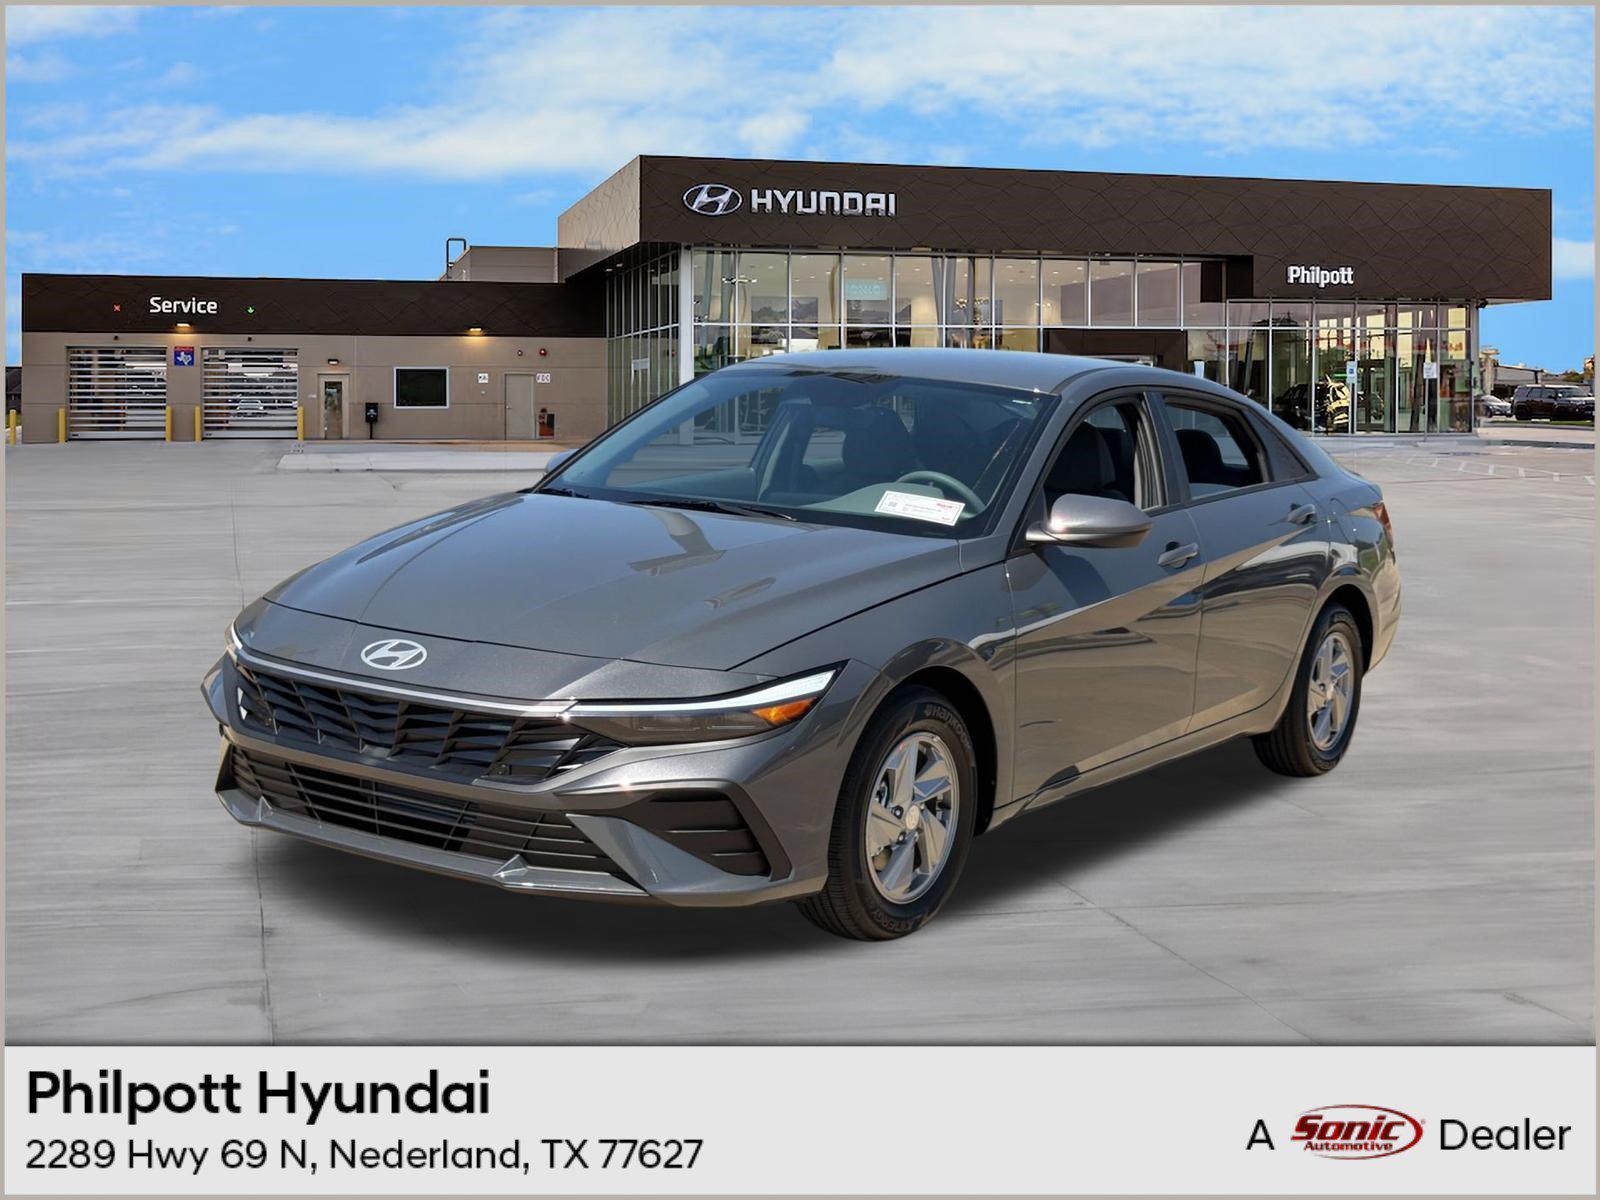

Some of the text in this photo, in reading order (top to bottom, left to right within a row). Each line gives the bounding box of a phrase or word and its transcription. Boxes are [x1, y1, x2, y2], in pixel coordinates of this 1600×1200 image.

[751, 189, 896, 216] HYUNDAI
[1287, 265, 1354, 288] Philpott
[149, 296, 218, 314] Service
